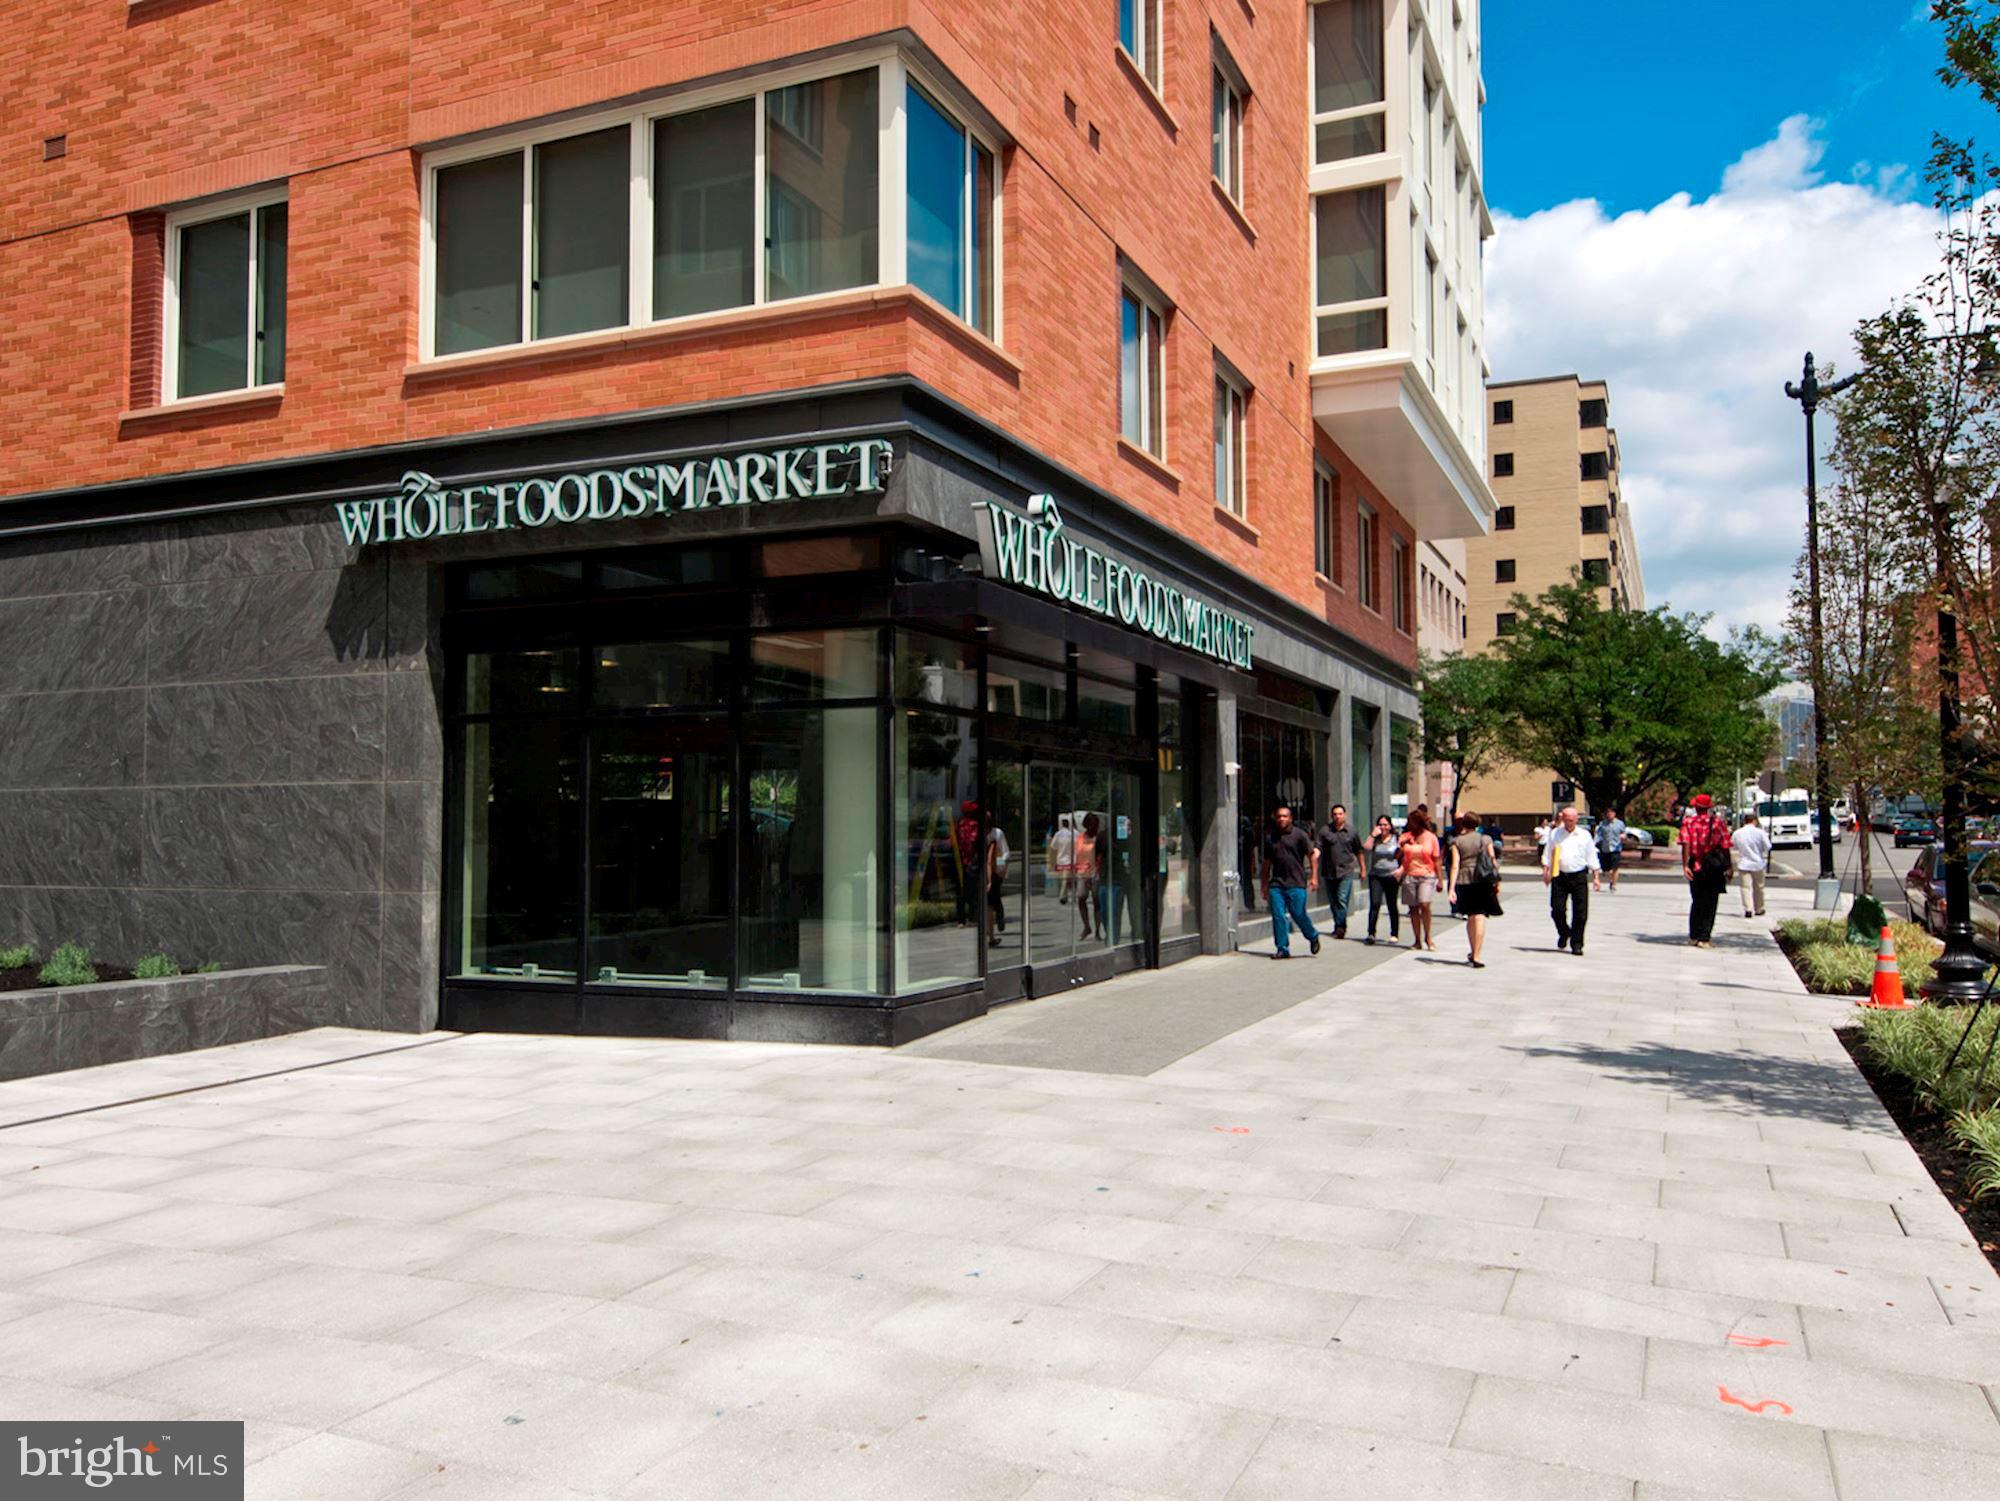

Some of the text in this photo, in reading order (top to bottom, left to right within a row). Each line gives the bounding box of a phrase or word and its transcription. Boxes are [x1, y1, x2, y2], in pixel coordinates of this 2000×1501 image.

[334, 439, 889, 546] WHOLE FOODS MARKET
[984, 493, 1254, 671] WHOLE FOODS MARKET
[1558, 783, 1570, 798] P
